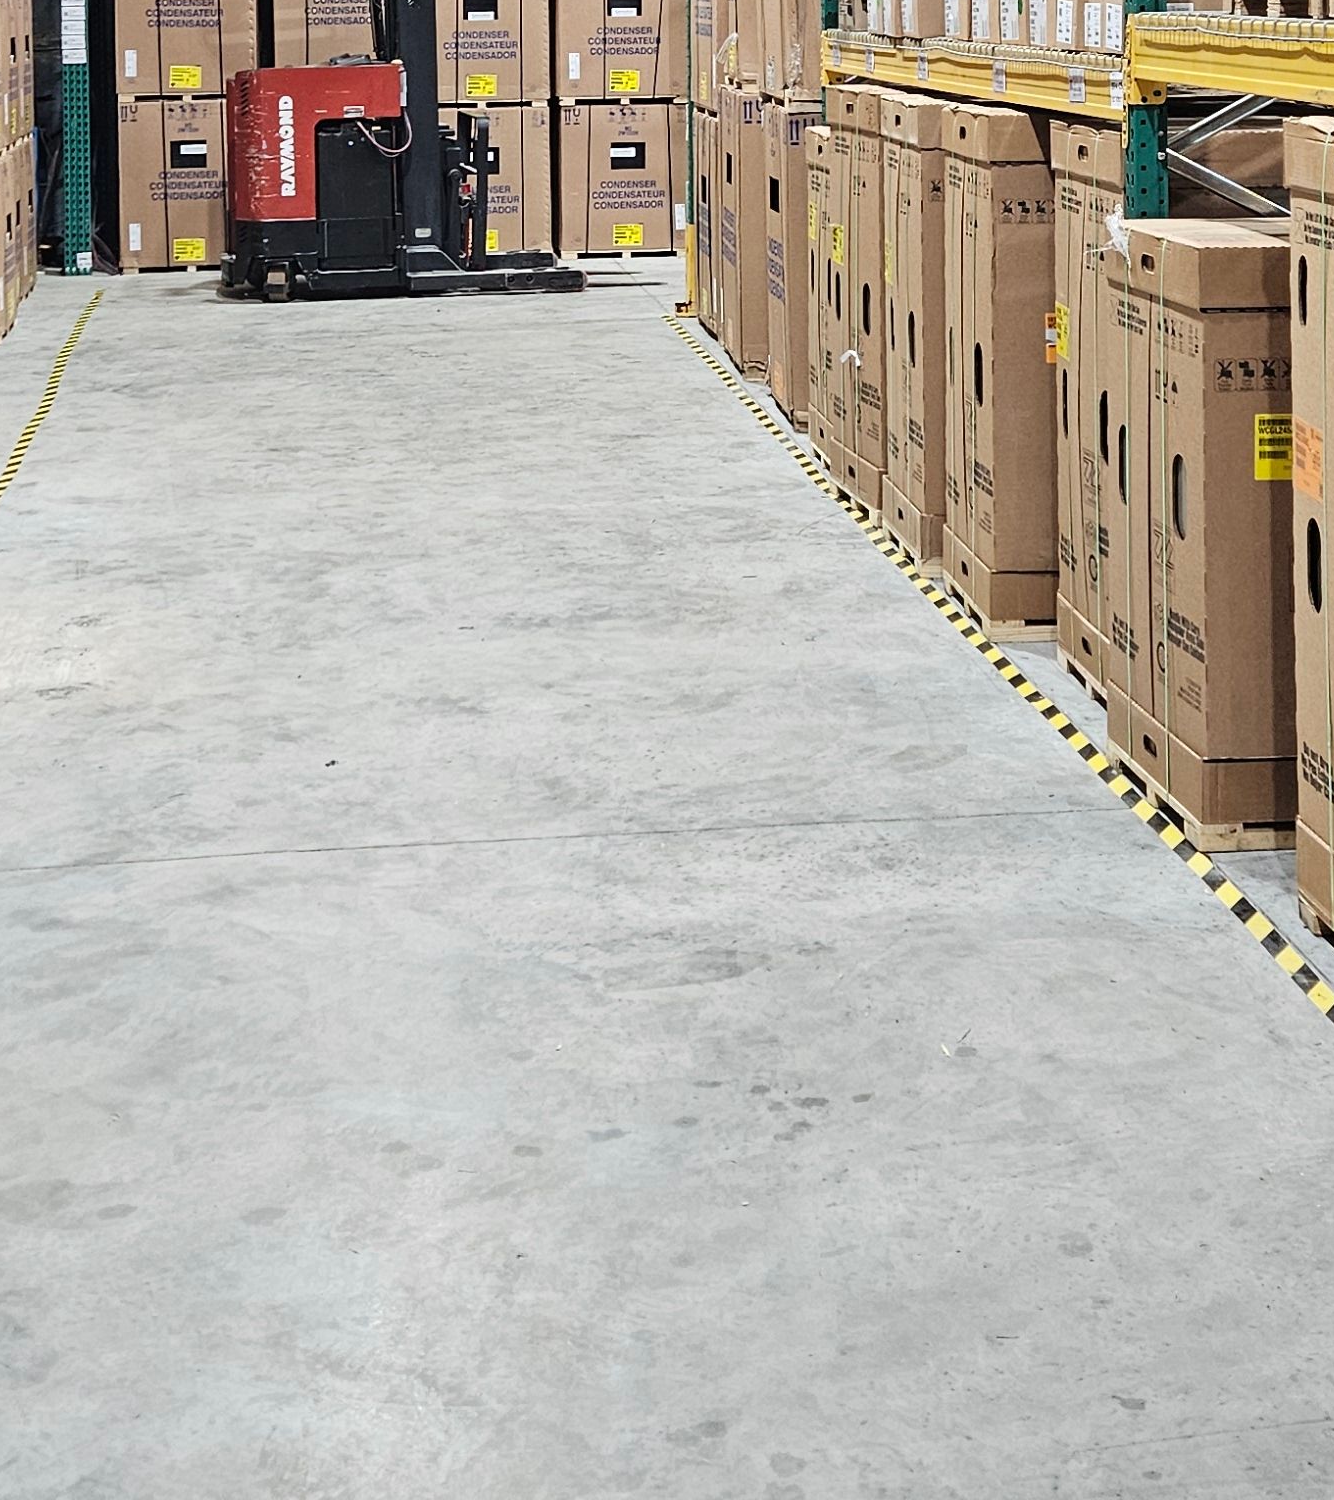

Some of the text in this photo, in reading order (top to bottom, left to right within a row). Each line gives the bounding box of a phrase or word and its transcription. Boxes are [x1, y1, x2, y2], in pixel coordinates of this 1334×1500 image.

[146, 9, 224, 18] CONDENSATEUR
[451, 30, 510, 39] CONDENSER
[596, 26, 653, 35] CONDENSER
[587, 36, 661, 45] CONDENSATEUR
[443, 41, 519, 50] CONDENSATEUR
[445, 51, 517, 60] CONDENSADOR
[589, 47, 660, 56] CONDENSADOR
[278, 95, 297, 198] RAYMOND
[158, 171, 218, 180] CONDENSER
[600, 180, 657, 189] CONDENSER
[592, 190, 666, 199] CONDENSATEUR
[593, 200, 664, 209] CONDENSADOR
